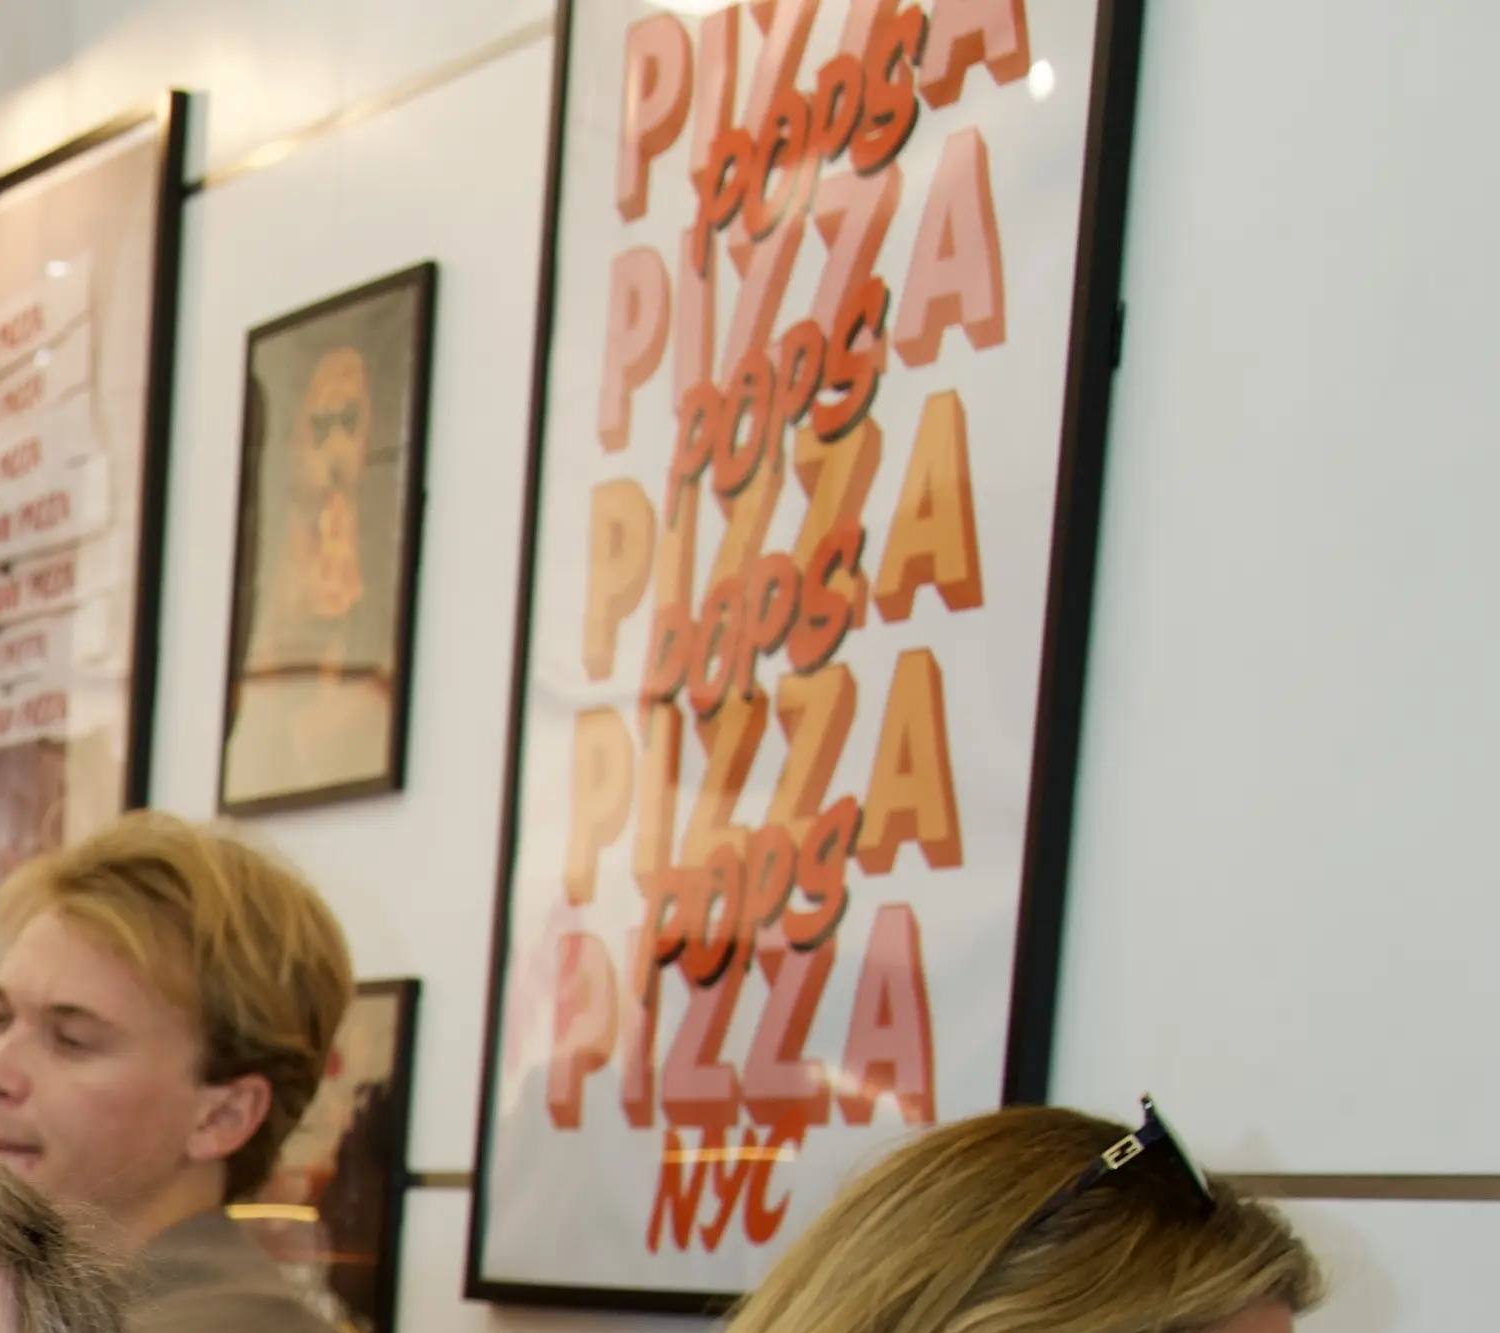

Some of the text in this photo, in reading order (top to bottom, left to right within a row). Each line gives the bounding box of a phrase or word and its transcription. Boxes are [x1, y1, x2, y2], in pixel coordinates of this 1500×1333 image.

[564, 647, 963, 906] PIZZA
[547, 902, 936, 1130] PIZZA
[646, 1112, 808, 1256] NYC
